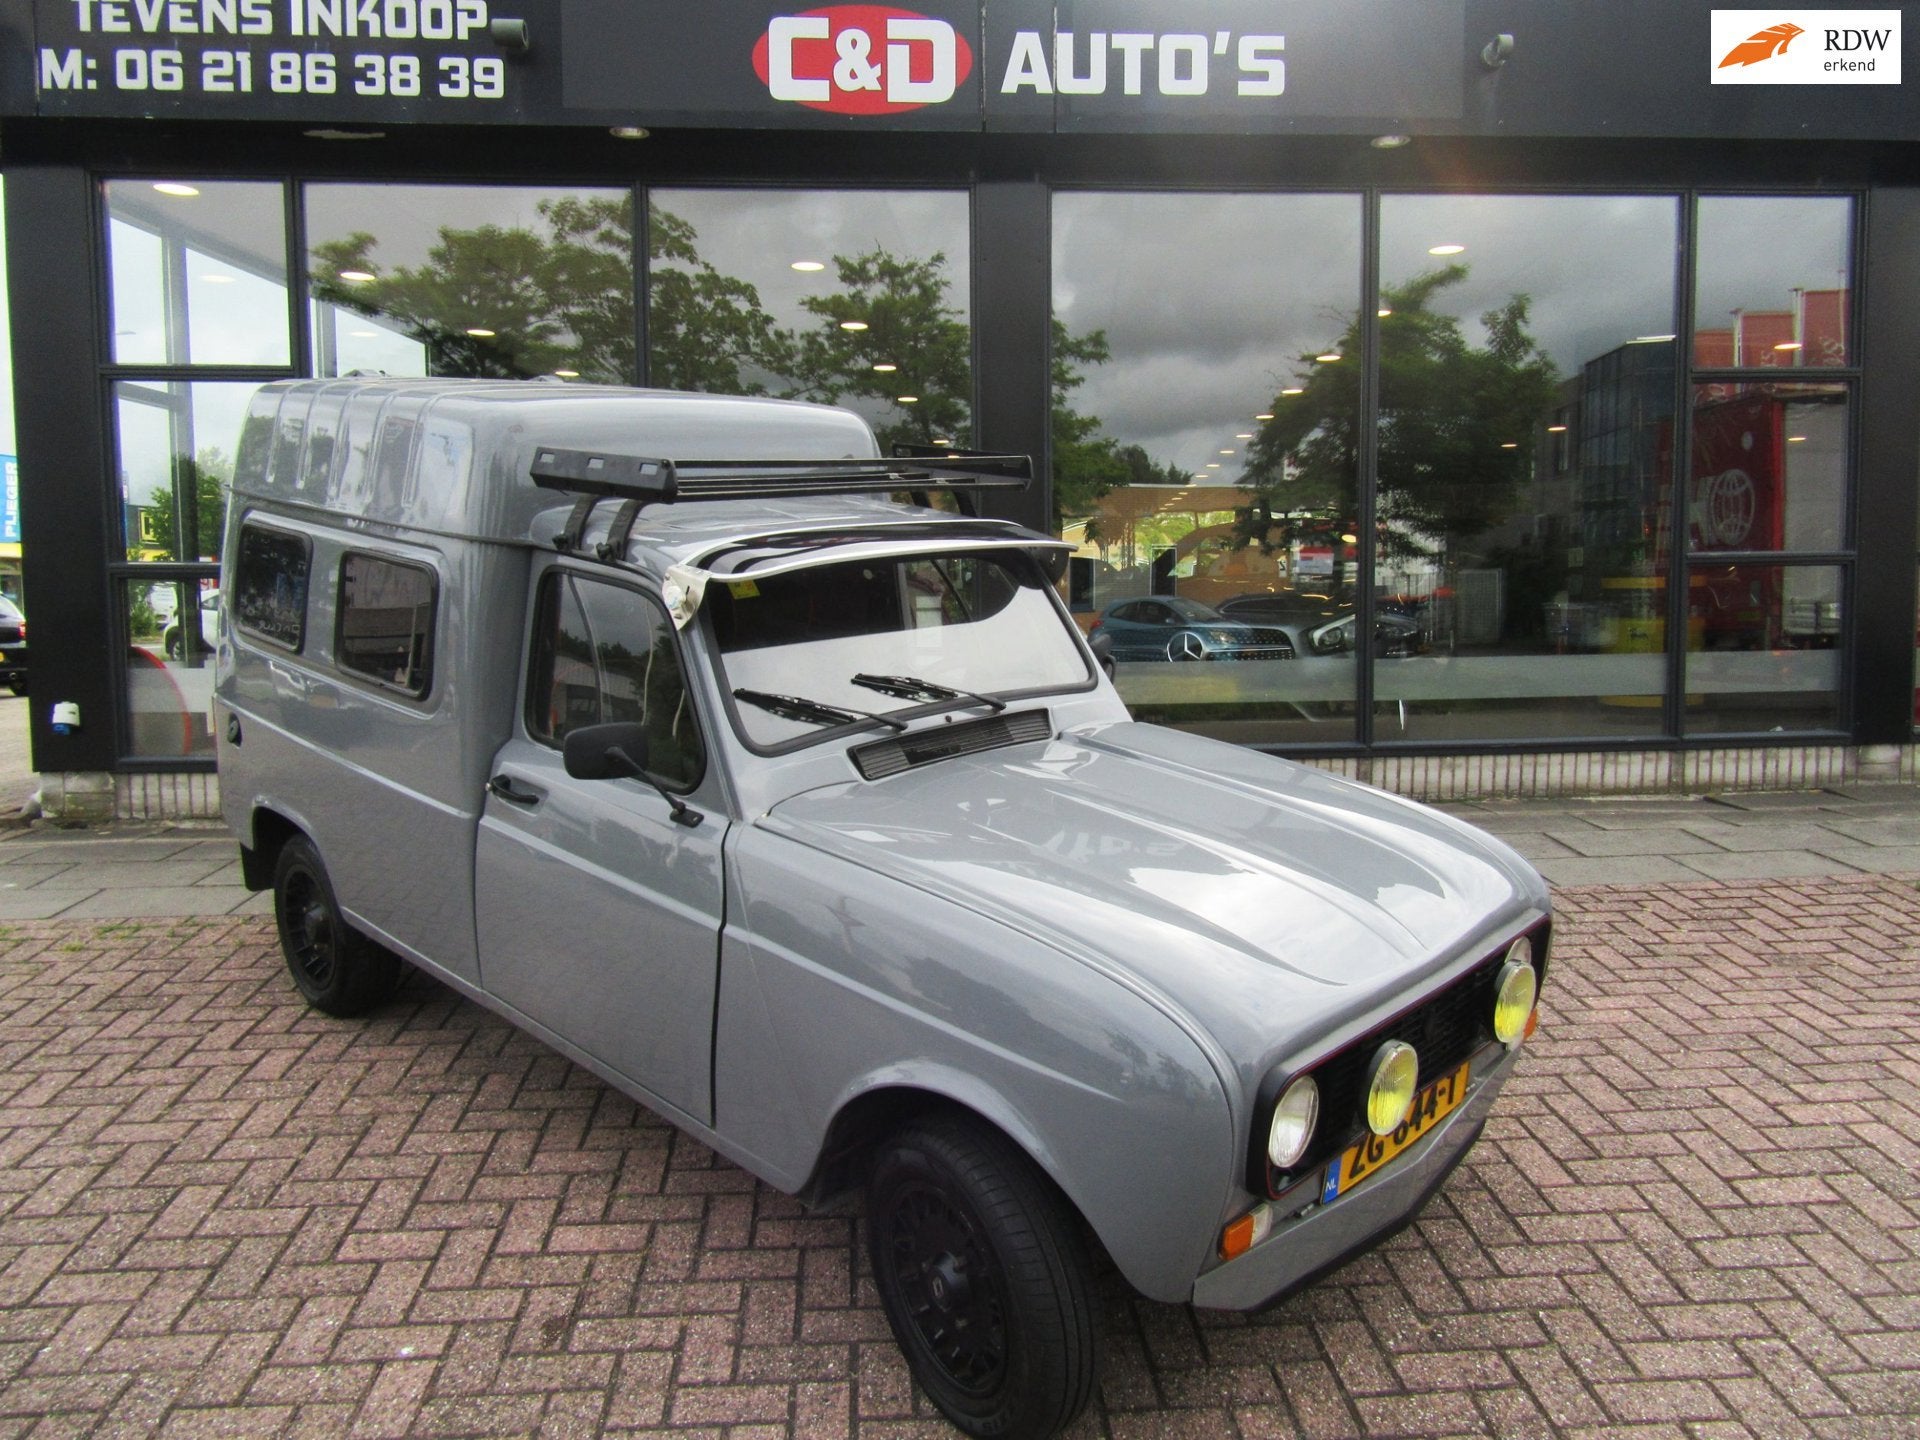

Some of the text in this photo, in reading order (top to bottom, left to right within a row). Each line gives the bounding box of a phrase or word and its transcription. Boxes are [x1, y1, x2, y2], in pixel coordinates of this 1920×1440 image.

[71, 0, 487, 40] TEVENS INKOOP
[41, 48, 504, 99] M: 06 21 86 38 39
[768, 16, 1285, 103] C&D AUTO'S
[5, 461, 18, 538] PLIEGER
[1325, 1179, 1337, 1192] NL
